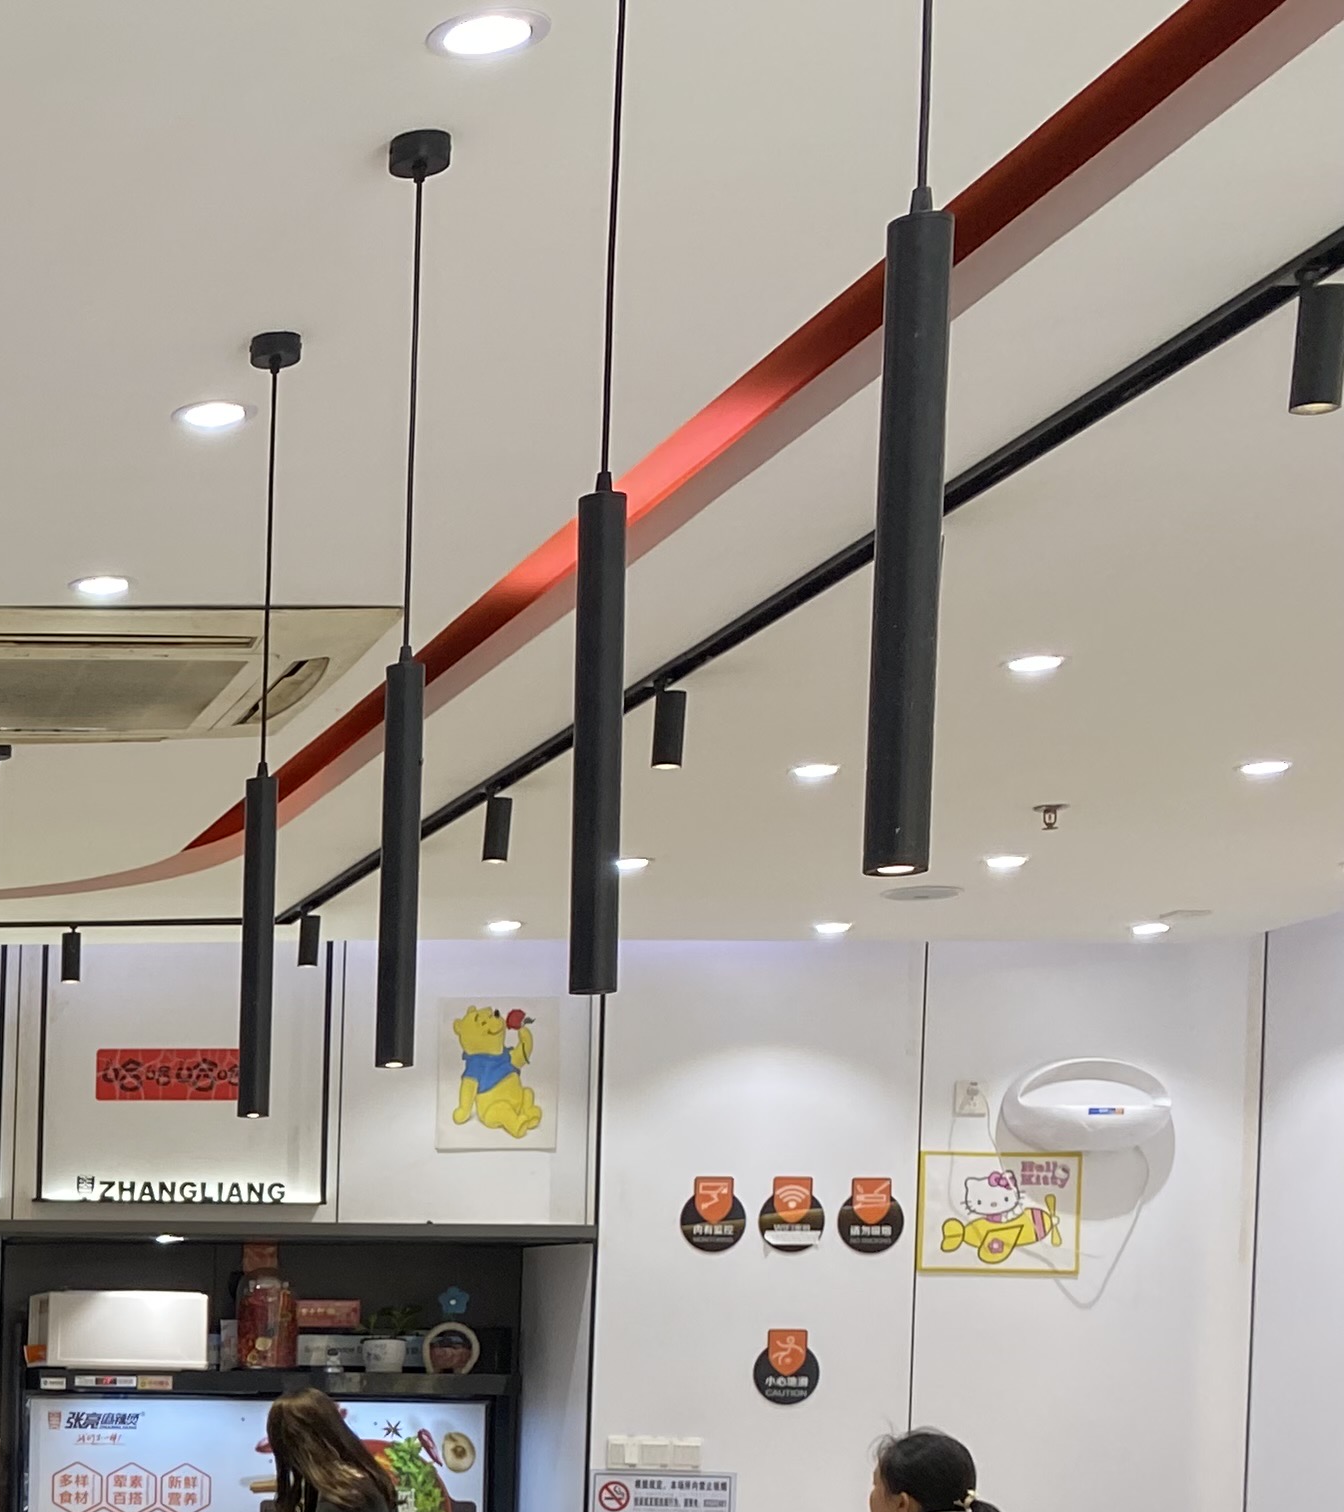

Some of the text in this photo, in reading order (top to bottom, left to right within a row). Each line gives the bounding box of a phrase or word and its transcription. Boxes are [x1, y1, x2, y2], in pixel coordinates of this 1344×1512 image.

[98, 1180, 286, 1202] ZHANGLIANG
[765, 1388, 808, 1398] CAUTION
[59, 1474, 88, 1488] 多样
